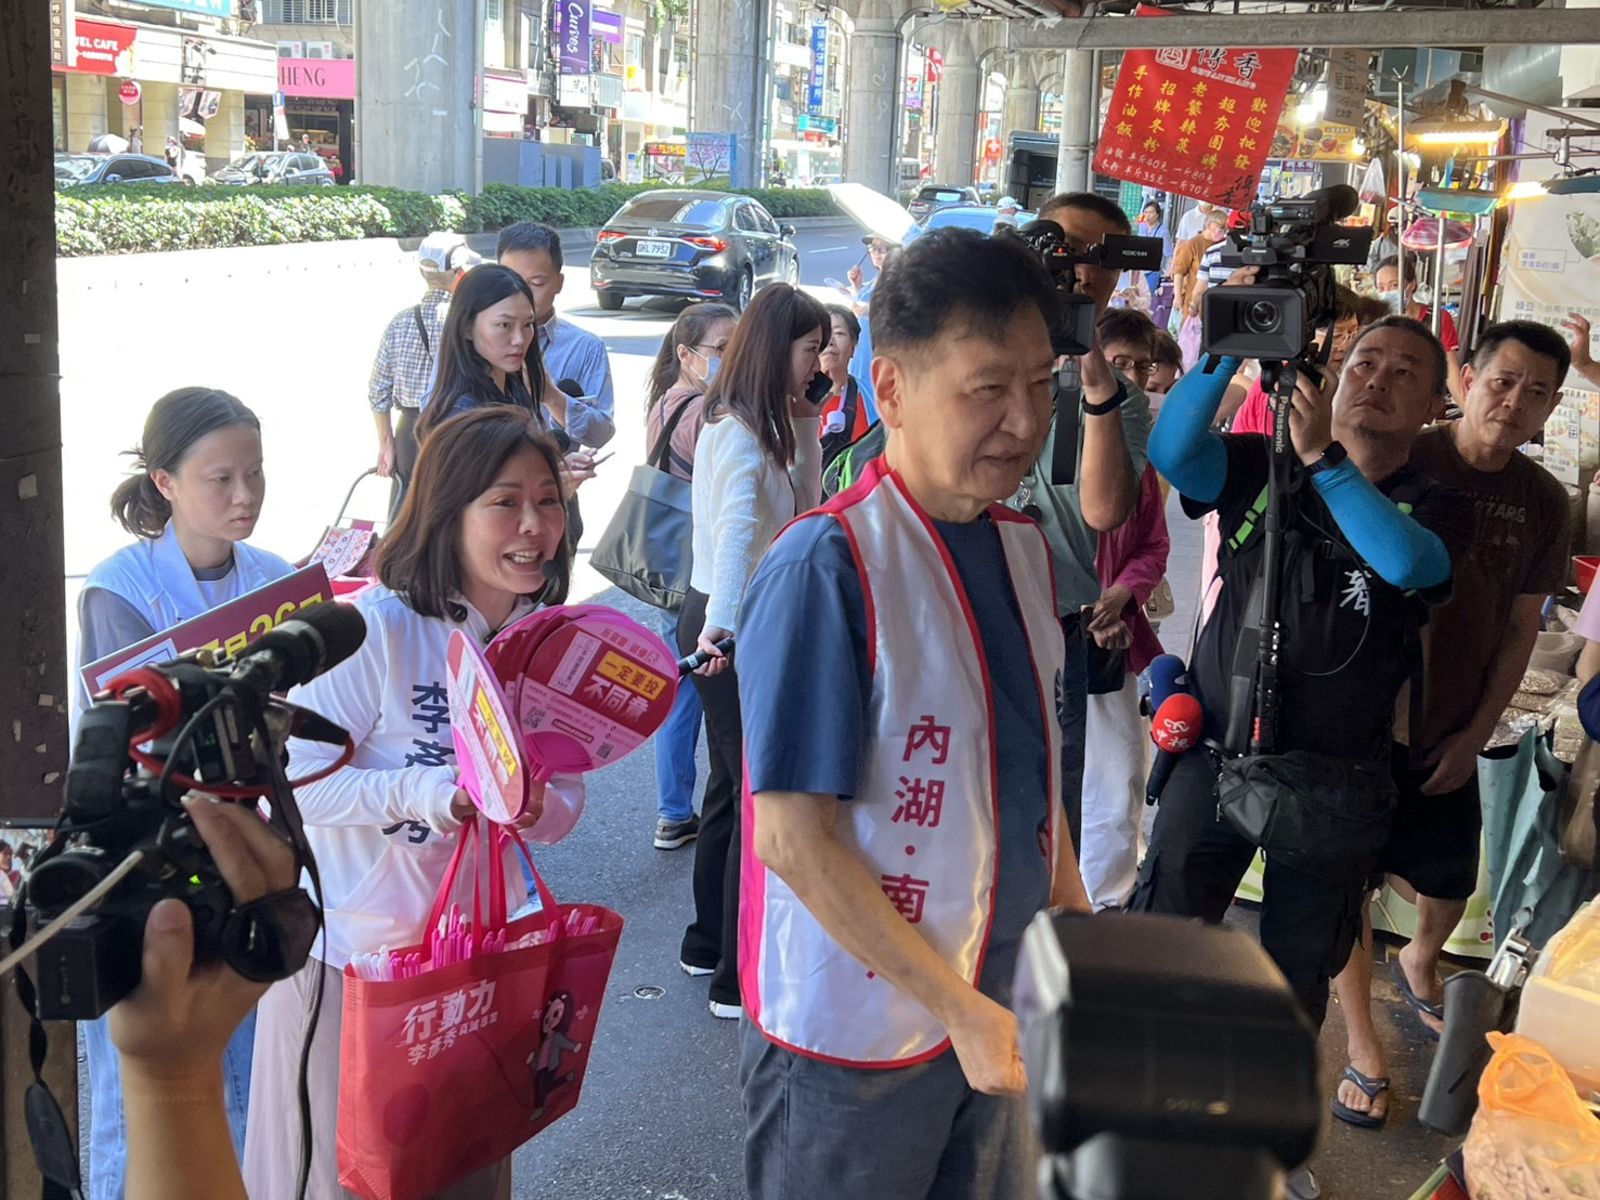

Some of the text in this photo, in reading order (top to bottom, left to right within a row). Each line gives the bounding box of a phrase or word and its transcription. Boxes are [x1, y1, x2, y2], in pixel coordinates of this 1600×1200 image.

[566, 2, 584, 53] Curves
[278, 66, 326, 87] HENG
[1114, 64, 1149, 138] 手作油飯
[1143, 79, 1177, 152] 招牌冬粉
[1233, 97, 1268, 170] 歡迎批發
[1275, 395, 1289, 454] Panasonic
[583, 673, 650, 722] 不同意
[604, 660, 660, 695] 一定要投
[397, 979, 497, 1047] 行動力
